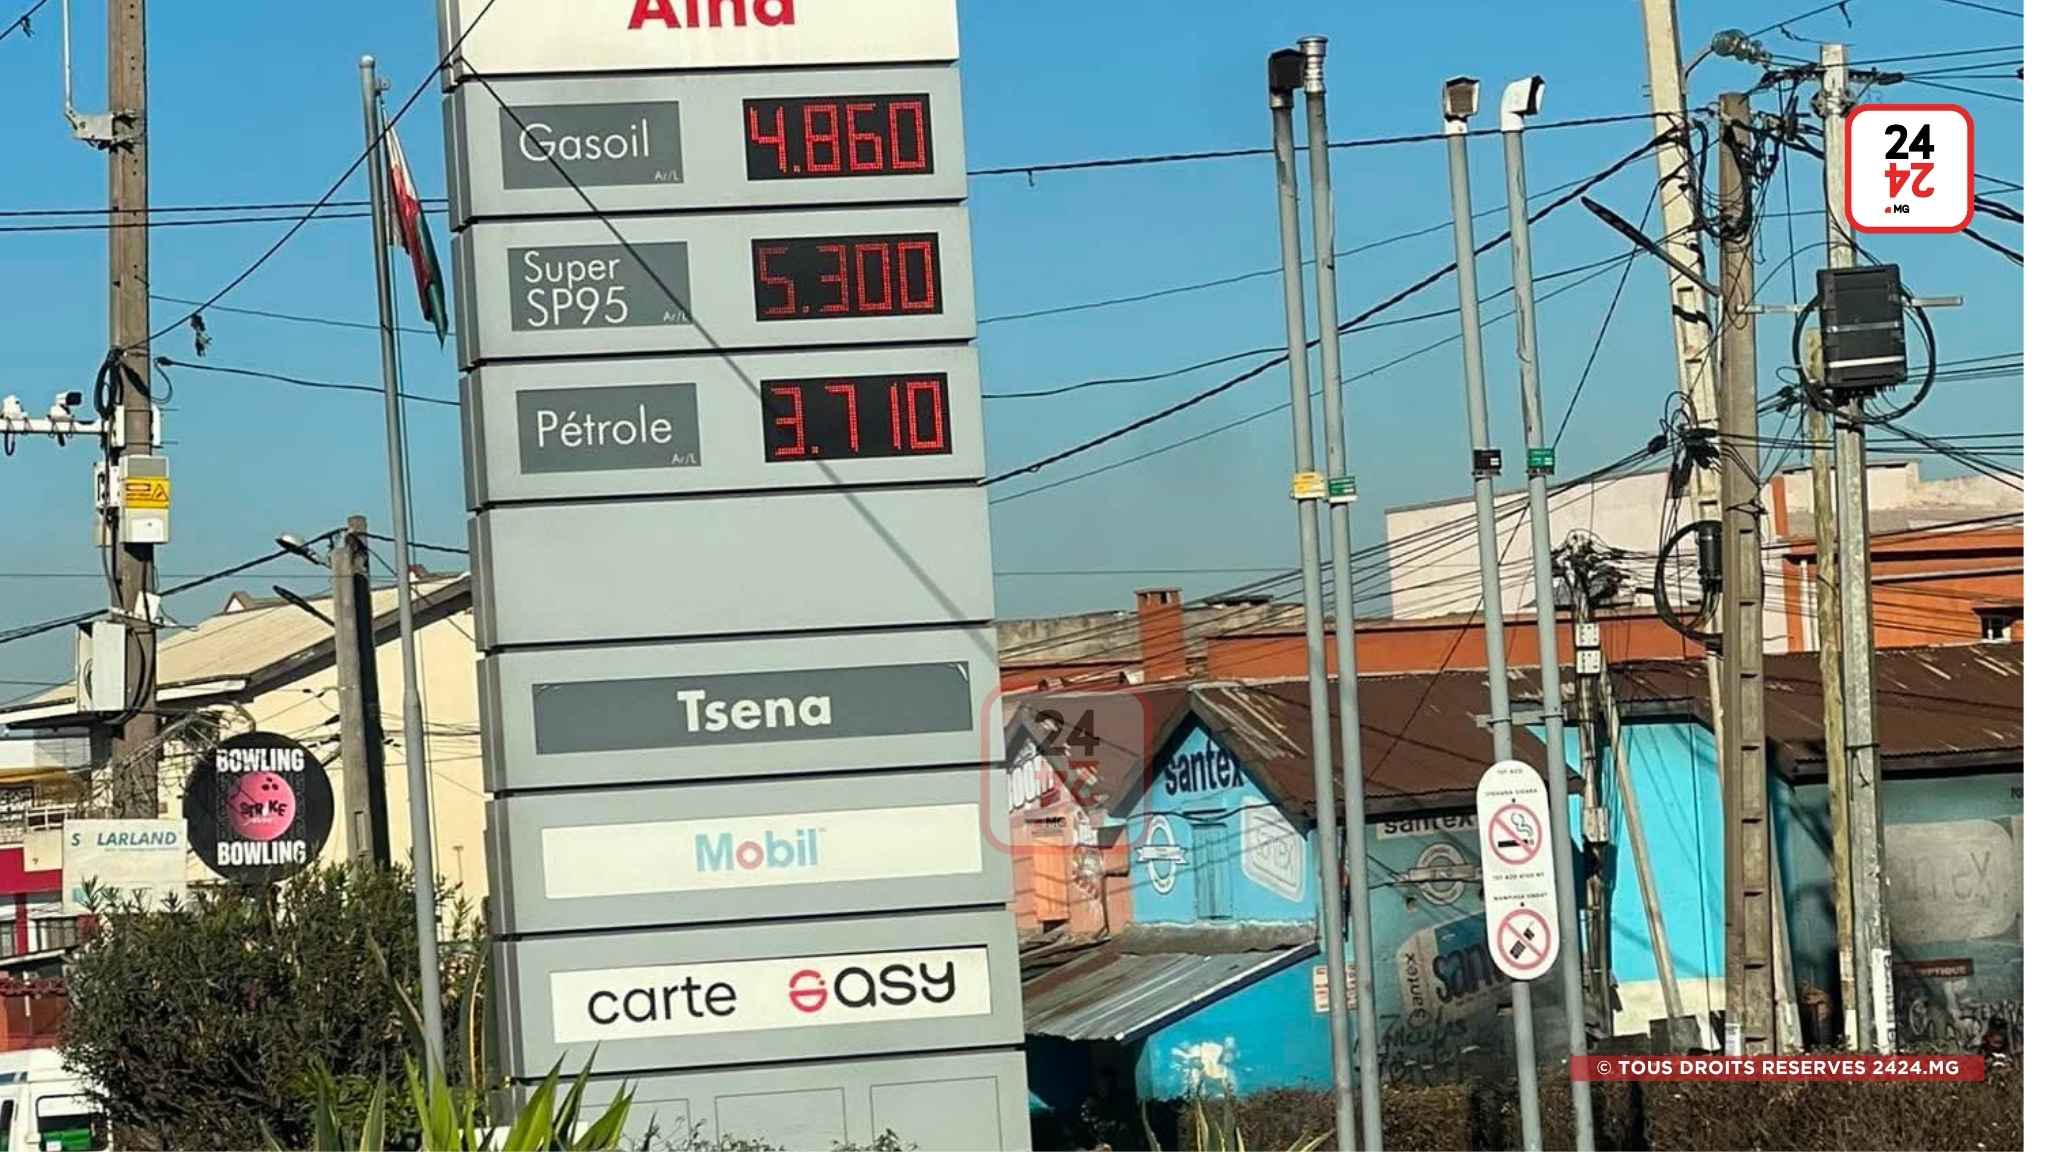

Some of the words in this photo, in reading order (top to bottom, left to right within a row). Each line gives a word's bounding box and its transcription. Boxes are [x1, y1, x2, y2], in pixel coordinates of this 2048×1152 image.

[518, 119, 651, 163] Gasoil
[750, 102, 926, 173] 4.860
[523, 251, 621, 288] Super
[758, 241, 935, 314] 5.300
[526, 285, 629, 327] SP95
[536, 404, 674, 448] Pétrole
[770, 380, 945, 457] 3.710
[677, 689, 832, 732] Tsena
[216, 748, 305, 772] BOWLING
[217, 840, 307, 866] BOWLING
[695, 828, 818, 872] Mobil
[587, 975, 737, 1025] carte
